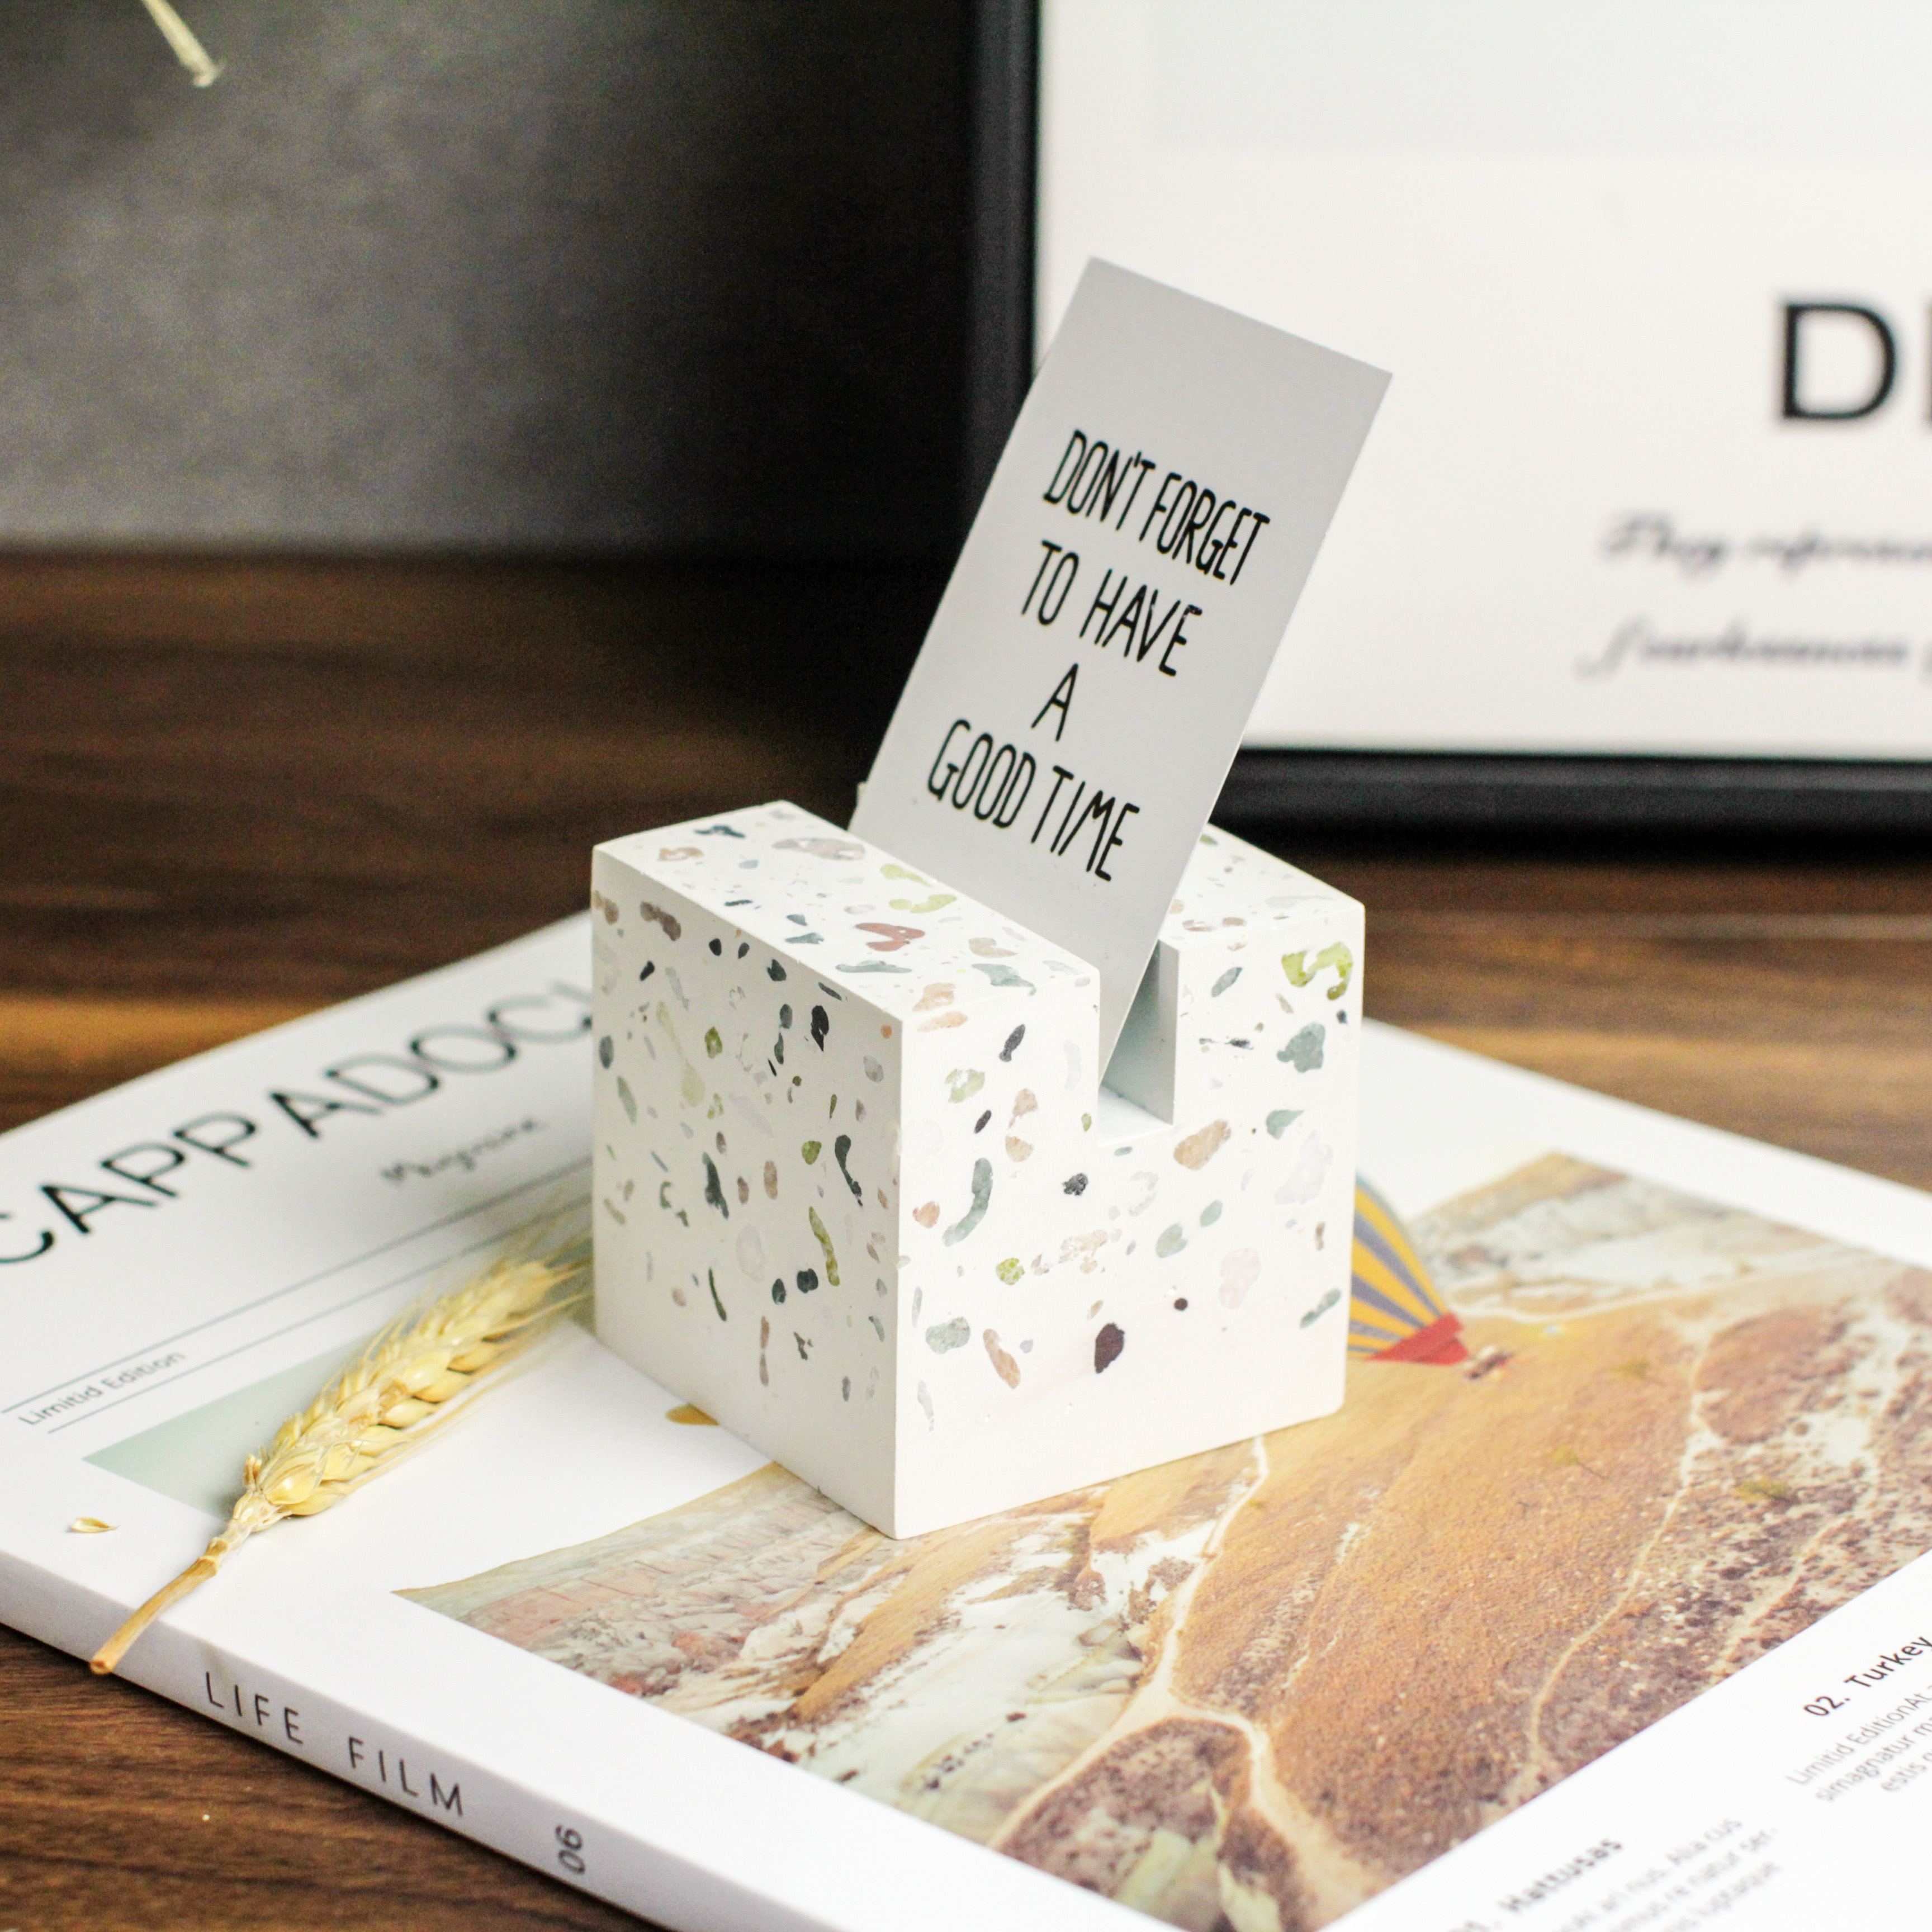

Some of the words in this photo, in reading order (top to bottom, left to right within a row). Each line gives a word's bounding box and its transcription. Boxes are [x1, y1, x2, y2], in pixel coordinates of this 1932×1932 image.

[1779, 299, 1932, 424] D
[1043, 429, 1156, 531] DON'T
[1139, 472, 1271, 586] FORGET
[1021, 539, 1079, 626] TO
[1079, 569, 1203, 677] HAVE
[1030, 663, 1078, 741] A
[927, 719, 1036, 828] GOOD
[1030, 765, 1140, 882] TIME
[18, 1385, 103, 1426] Limitid
[101, 1352, 186, 1389] Edition
[1803, 1696, 1850, 1716] 02.
[1843, 1636, 1932, 1687] Turkey
[205, 1671, 304, 1745] LIFE
[348, 1736, 464, 1816] FILM
[1786, 1742, 1854, 1785] Limitid
